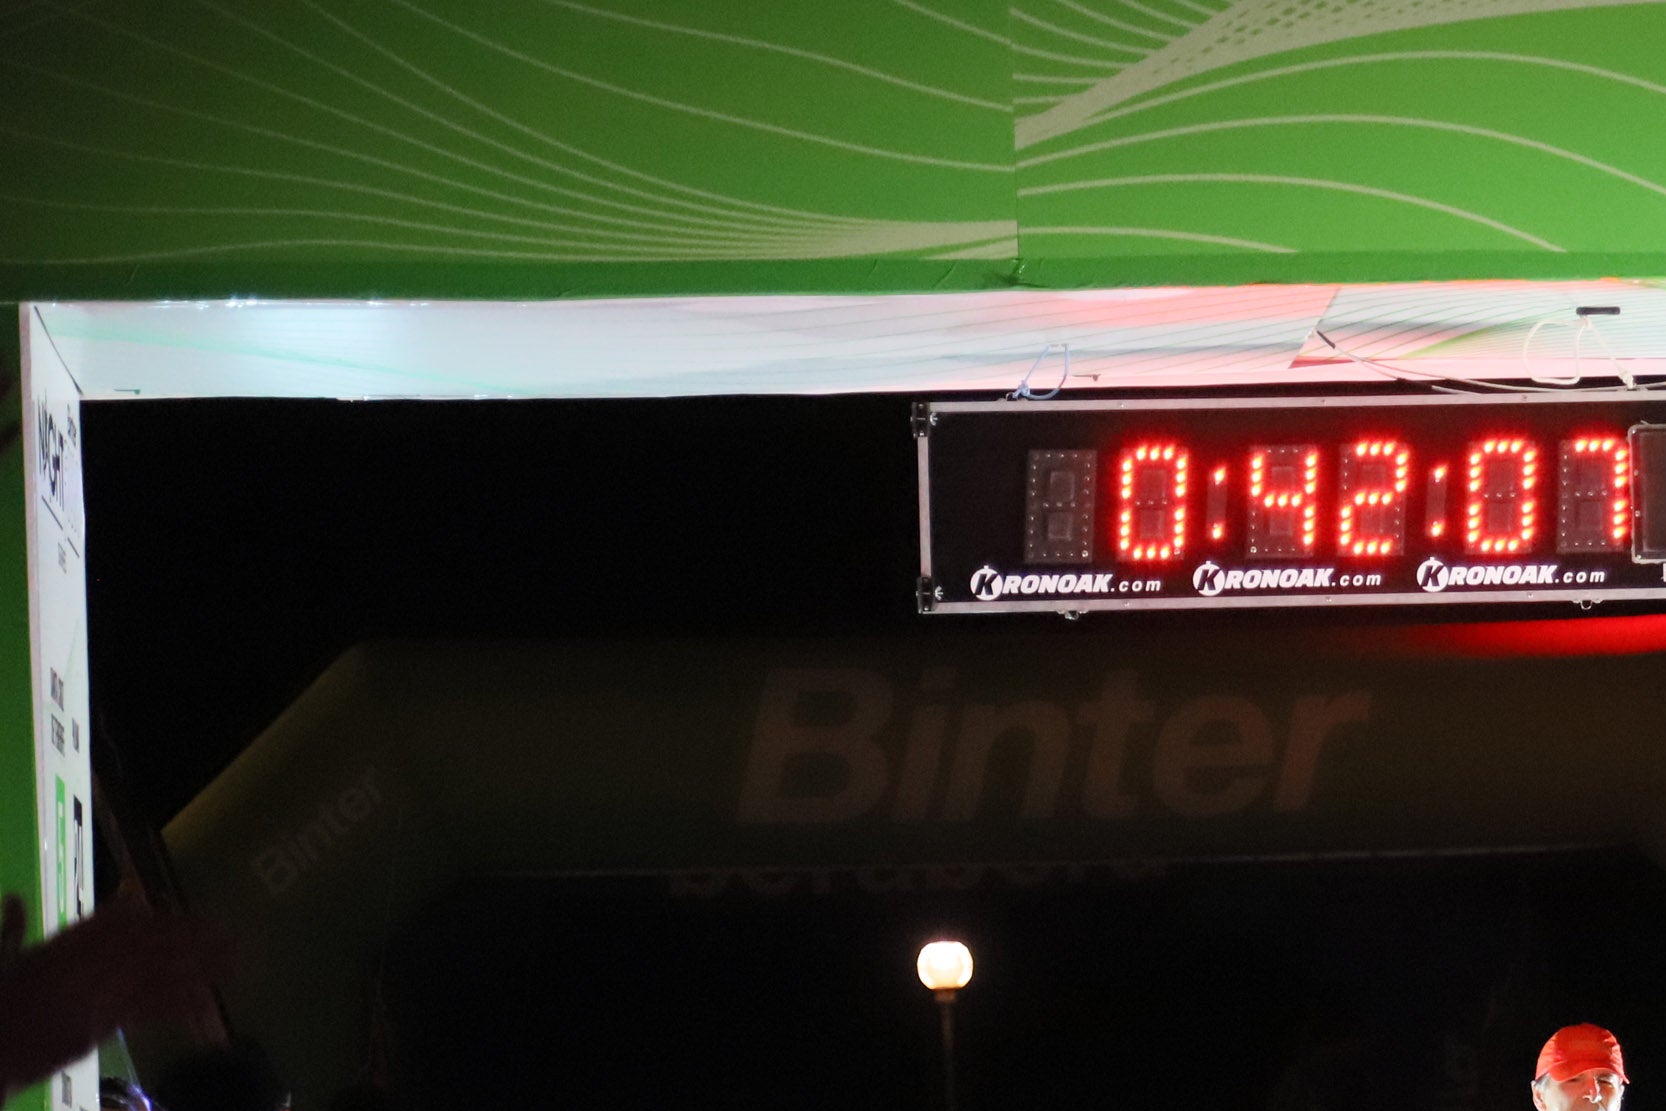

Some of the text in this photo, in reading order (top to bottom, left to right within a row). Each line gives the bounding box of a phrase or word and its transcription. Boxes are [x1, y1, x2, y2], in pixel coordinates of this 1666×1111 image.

[1117, 437, 1631, 559] 0:42:07
[970, 566, 1162, 601] KRONOAK.com
[1192, 561, 1382, 597] KRONOAK.com
[1416, 557, 1606, 593] KRONOAK.com
[732, 666, 1375, 826] Binter
